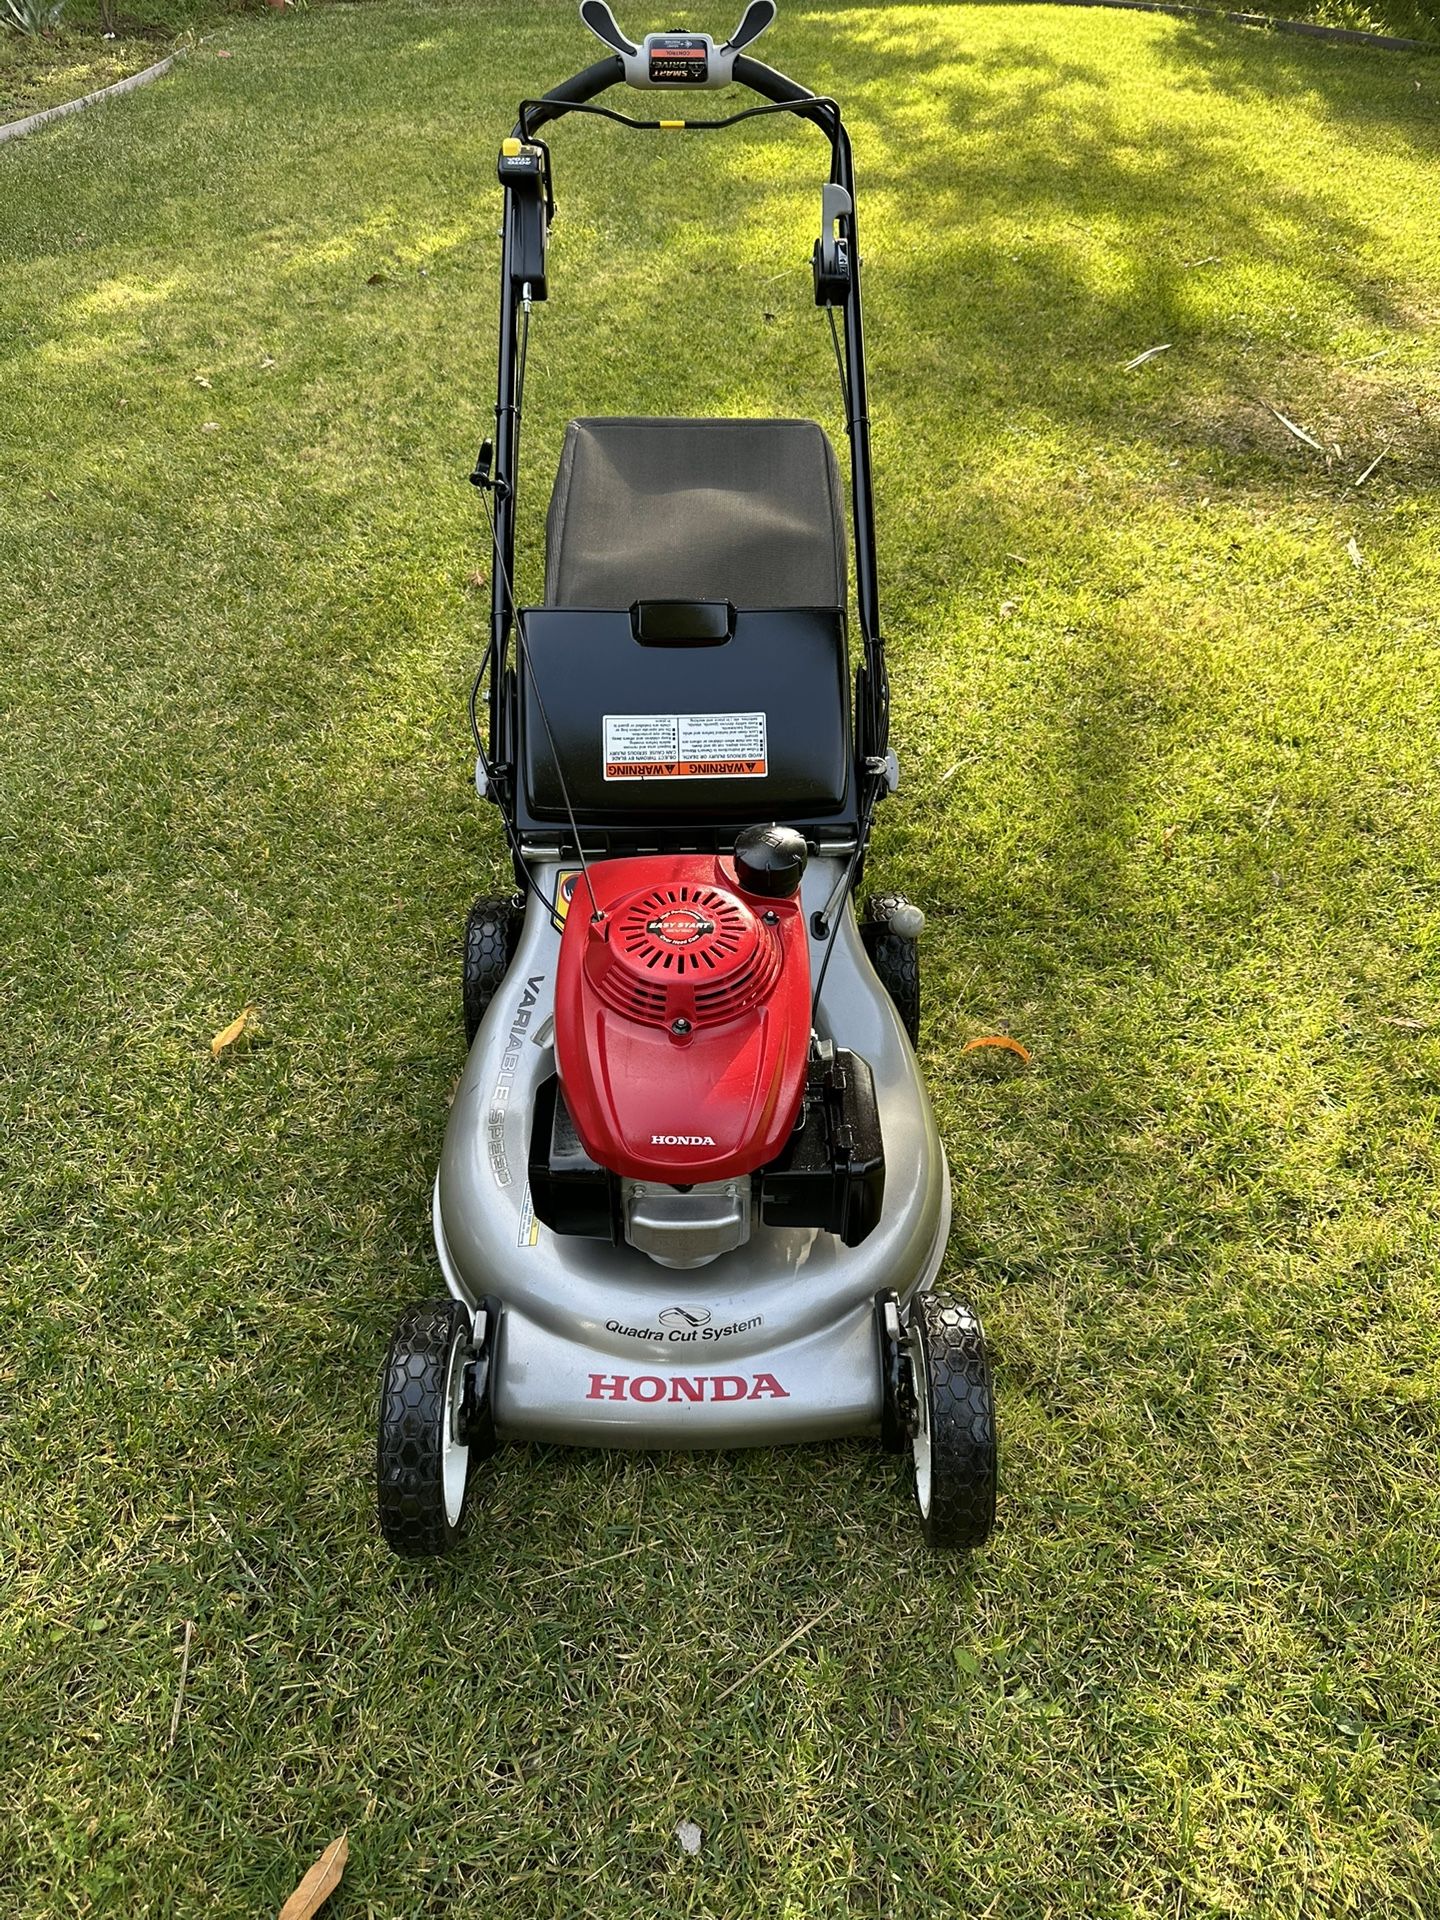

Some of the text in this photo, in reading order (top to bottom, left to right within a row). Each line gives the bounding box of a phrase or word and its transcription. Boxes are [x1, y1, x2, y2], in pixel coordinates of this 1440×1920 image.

[609, 766, 663, 775] WARNING
[689, 763, 744, 773] WARNING
[488, 975, 545, 1188] VARIABLE SPEED
[651, 1135, 716, 1146] HONDA
[606, 1316, 762, 1341] Quadra Cut System
[585, 1374, 790, 1402] HONDA
